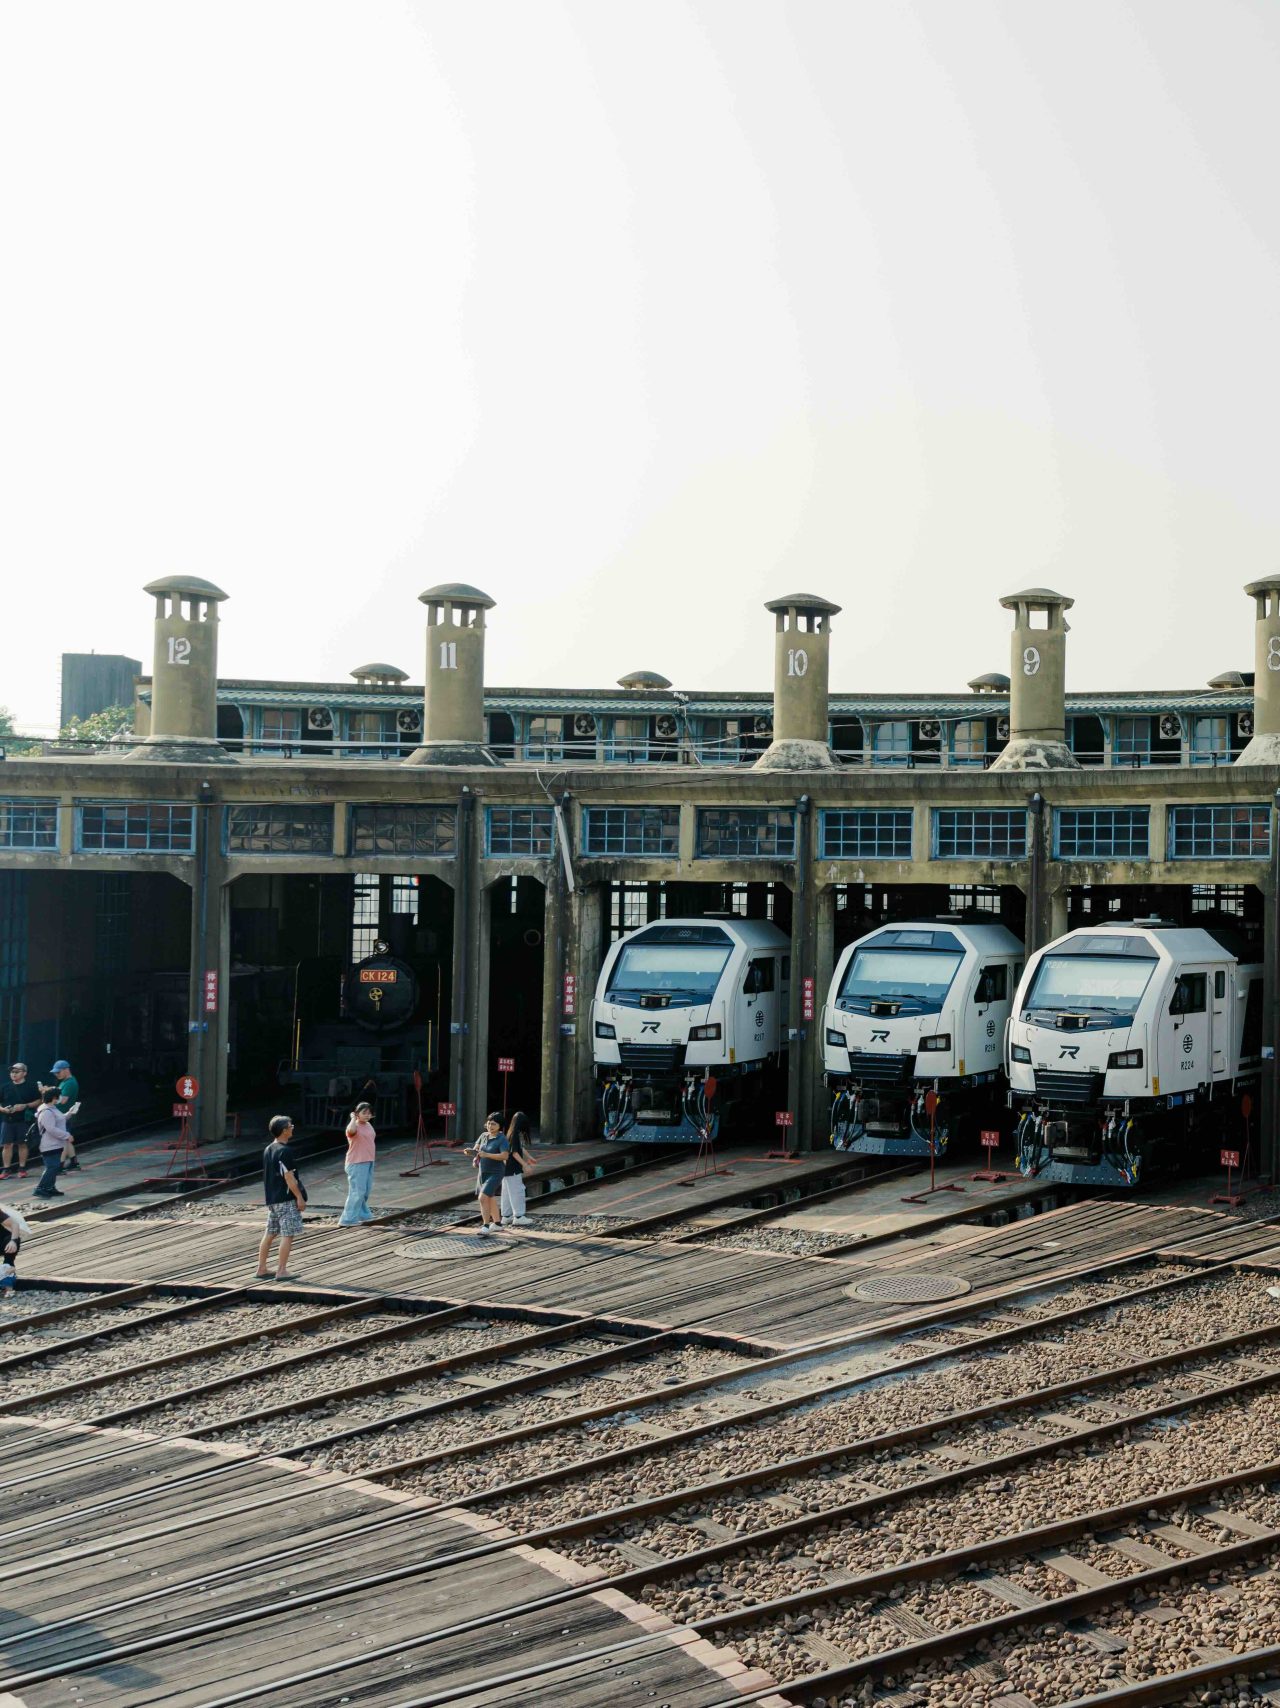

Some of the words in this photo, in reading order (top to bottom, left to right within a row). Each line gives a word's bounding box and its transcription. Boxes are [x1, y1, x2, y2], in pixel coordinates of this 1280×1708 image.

[167, 637, 192, 665] 12
[439, 642, 458, 669] 11
[787, 649, 809, 676] 10
[1023, 646, 1040, 676] 9
[361, 973, 376, 982] CK
[378, 972, 395, 982] 124
[1181, 1061, 1194, 1070] R224
[183, 1078, 194, 1097] 禁動
